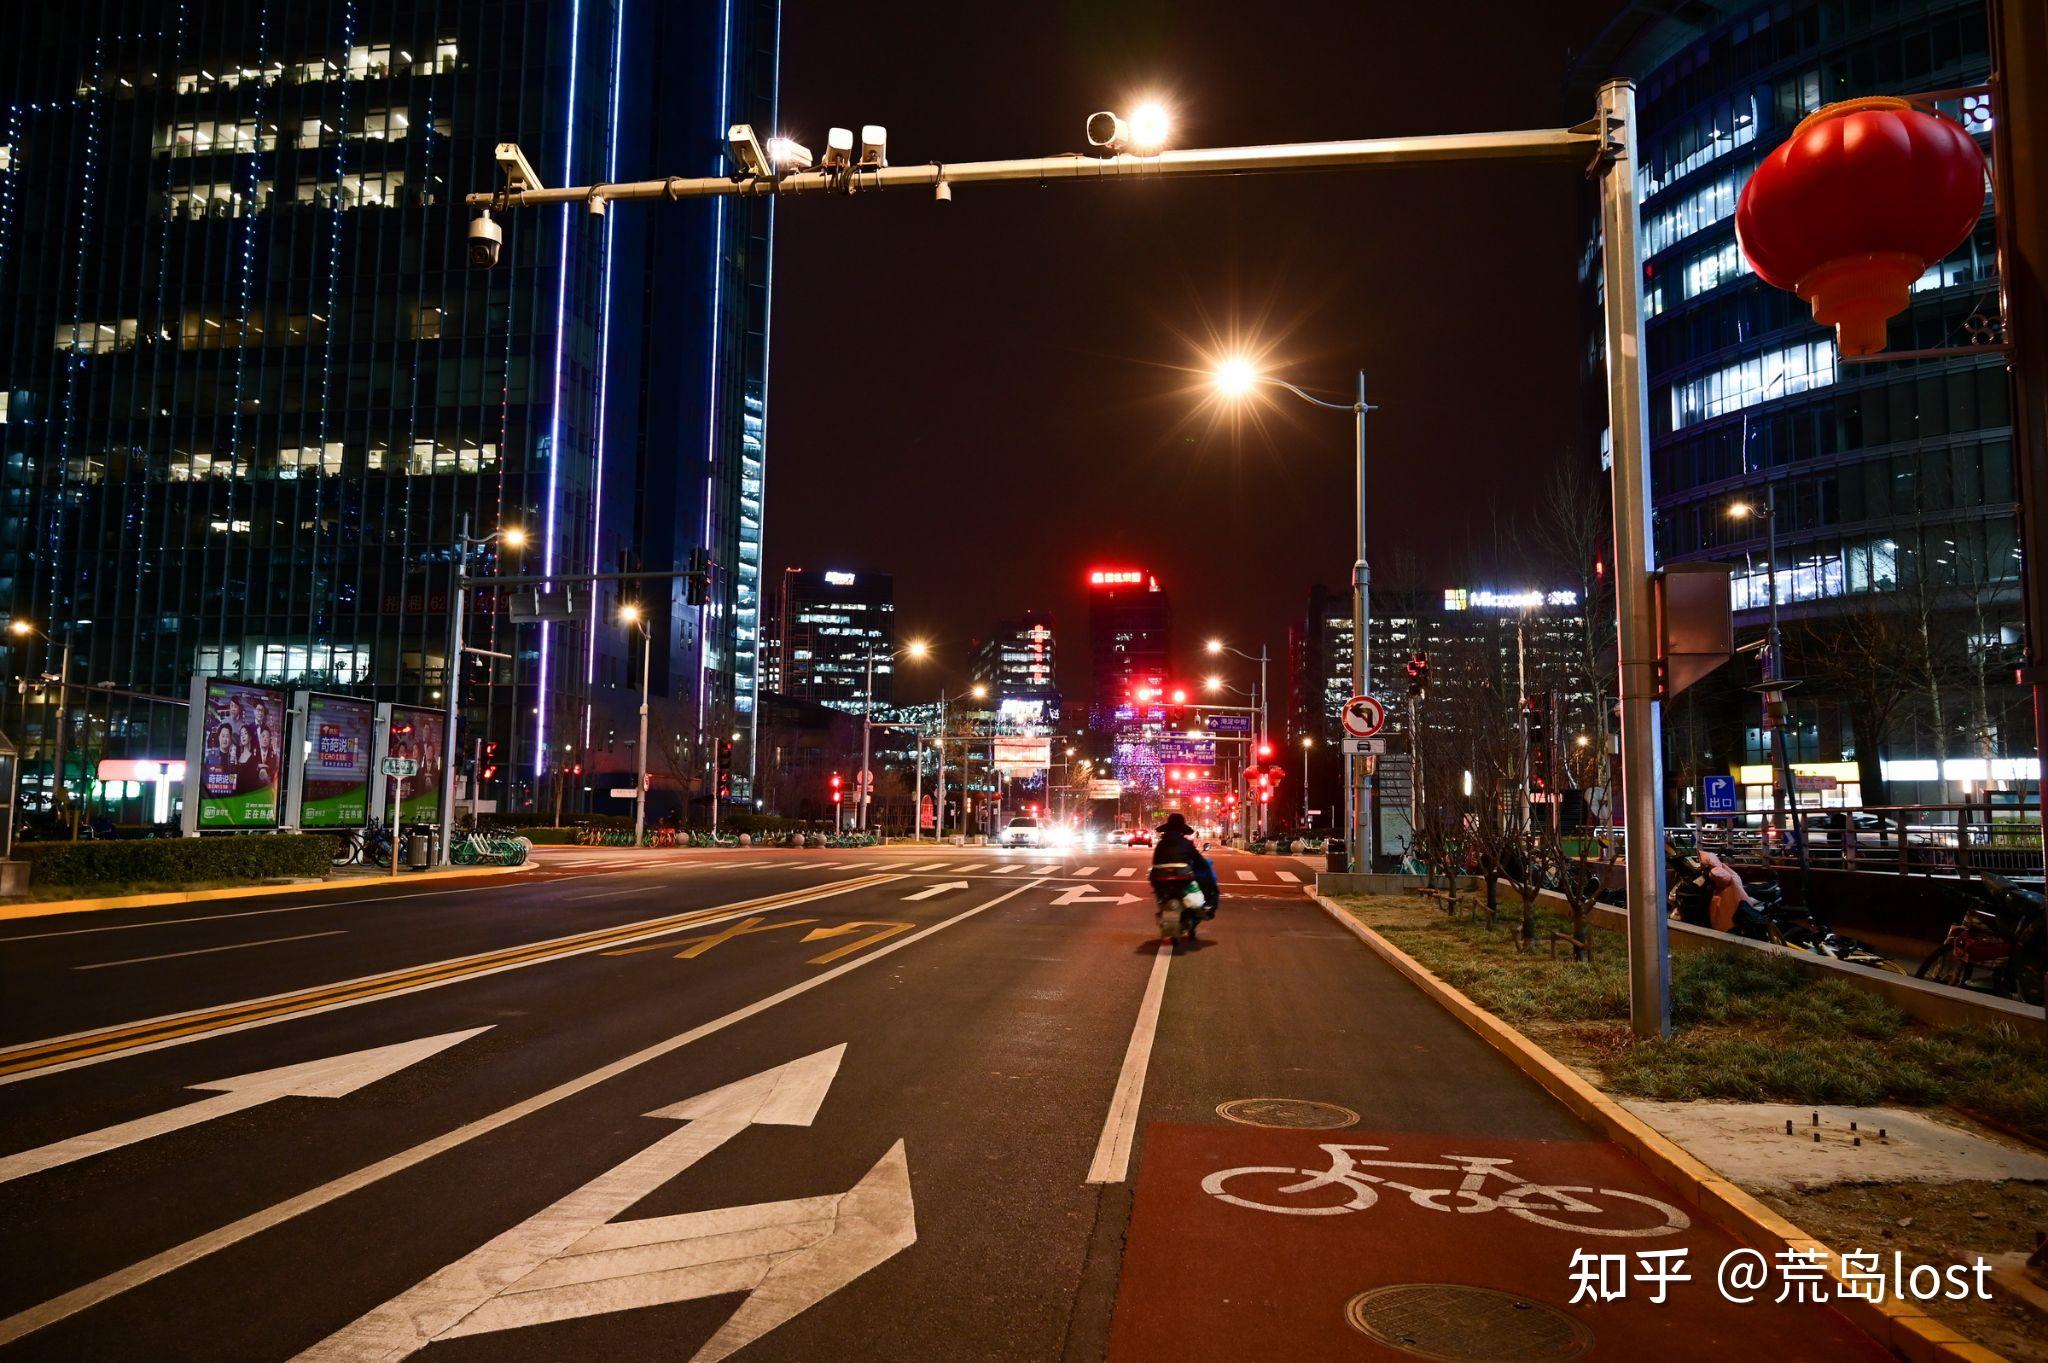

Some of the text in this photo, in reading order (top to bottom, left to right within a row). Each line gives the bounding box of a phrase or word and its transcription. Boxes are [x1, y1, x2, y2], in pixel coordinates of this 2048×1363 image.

[1470, 590, 1544, 607] Microsoft
[321, 737, 348, 753] 奇葩说
[1709, 796, 1732, 808] 出口
